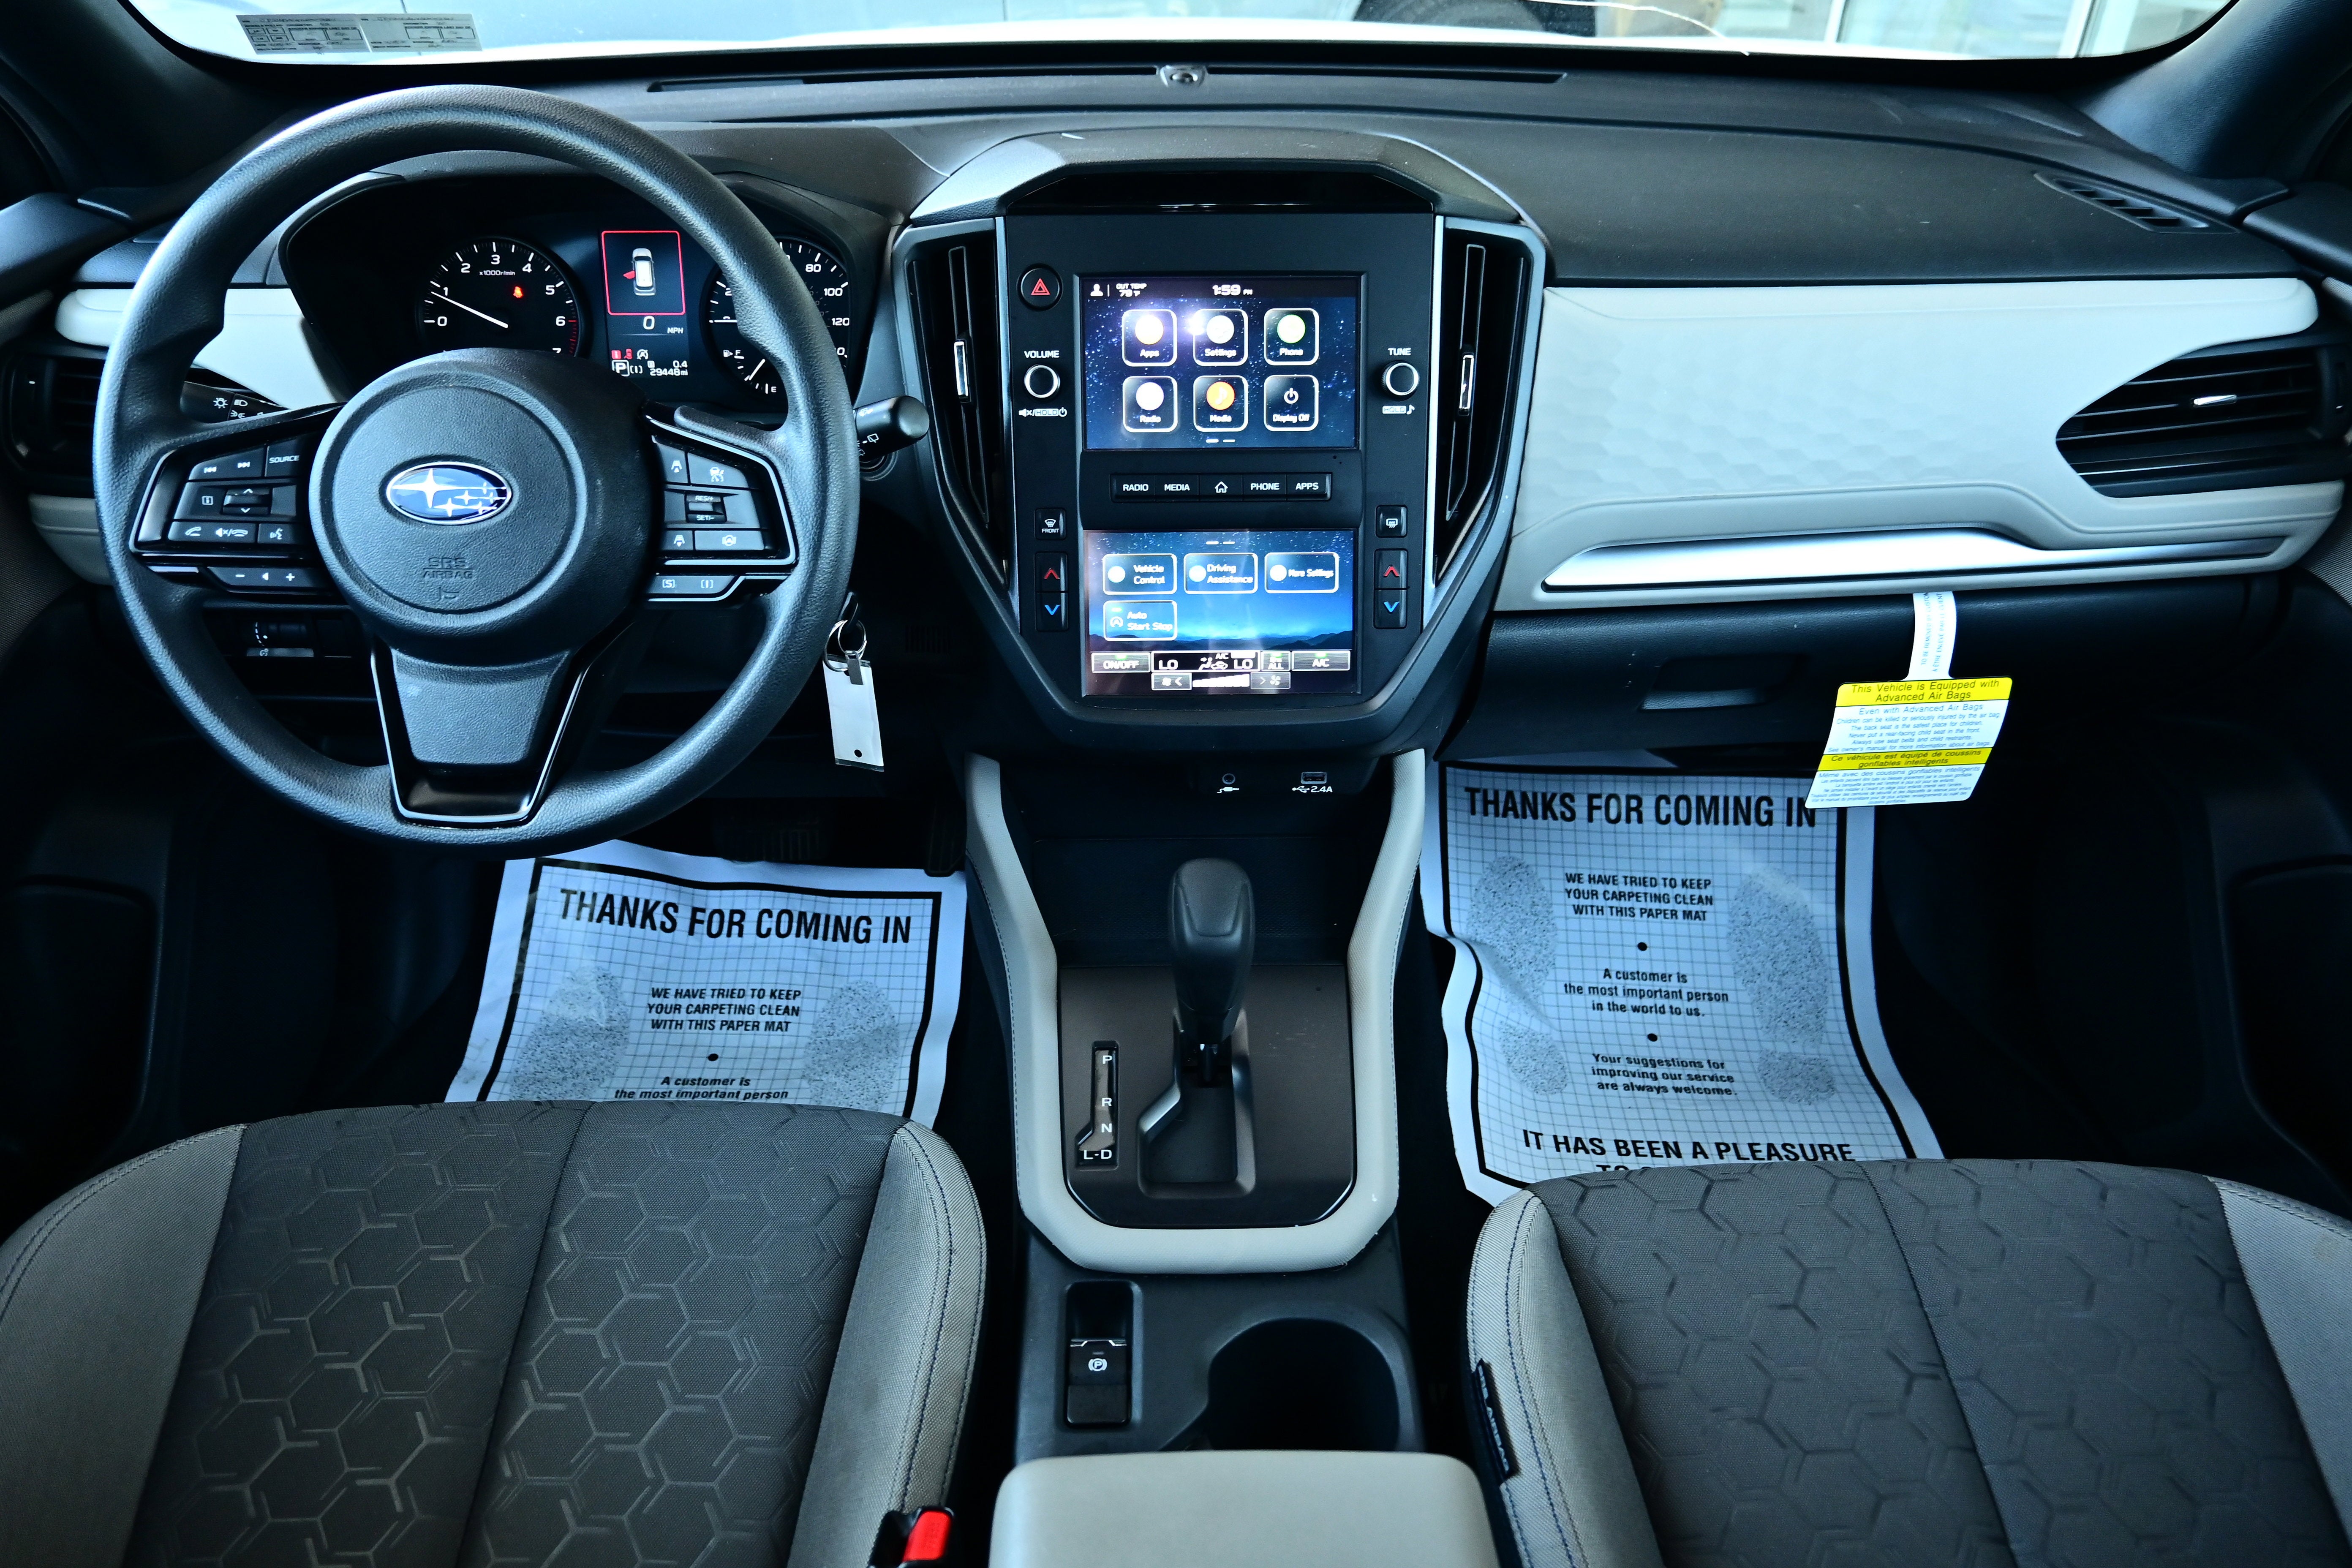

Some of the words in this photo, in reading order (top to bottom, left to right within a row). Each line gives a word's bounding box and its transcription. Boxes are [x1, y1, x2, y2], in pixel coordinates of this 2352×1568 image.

[491, 254, 500, 264] 3
[461, 263, 470, 273] 2
[523, 263, 532, 273] 4
[806, 264, 821, 272] 80
[443, 287, 448, 296] 1
[546, 285, 555, 295] 5
[824, 288, 843, 296] 100
[1212, 284, 1241, 296] 1:59
[437, 316, 447, 326] 0
[556, 316, 565, 326] 6
[643, 316, 655, 329] 0
[832, 318, 850, 326] 120
[1024, 350, 1060, 358] VOLUME
[1140, 349, 1160, 358] Apps
[1205, 348, 1236, 358] Settings
[1279, 348, 1304, 356] Phone
[1388, 348, 1411, 356] TUNE
[615, 363, 626, 373] P
[1140, 415, 1161, 423] Radio
[1210, 414, 1232, 422] Media
[1273, 414, 1297, 423] Display
[1298, 414, 1310, 422] Off
[269, 455, 299, 463] SOURCE
[1164, 483, 1190, 491] MEDIA
[428, 557, 465, 568] SRS
[1133, 565, 1164, 573] Vehicle
[1207, 564, 1236, 574] Driving
[1288, 569, 1305, 577] More
[1307, 569, 1334, 579] Settings
[423, 571, 473, 579] AIRBAG
[1133, 576, 1165, 584] Control
[1207, 575, 1253, 583] Assistance
[1127, 612, 1147, 620] Auto
[1127, 623, 1150, 631] Start
[1152, 623, 1173, 632] Stop
[1103, 660, 1139, 669] ON/OFF
[1159, 660, 1179, 670] LO
[1233, 659, 1253, 669] LO
[1312, 659, 1330, 667] A/C
[1851, 684, 1872, 693] This
[1877, 683, 1912, 692] Vehicle
[1916, 682, 1925, 690] is
[1930, 680, 1976, 691] Equipped
[1875, 692, 1925, 702] Advanced
[1928, 692, 1943, 700] Air
[1946, 691, 1971, 701] Bags
[1963, 703, 1983, 711] Bags
[1901, 751, 1928, 759] équipé
[1859, 760, 1901, 769] gonflables
[1465, 787, 1576, 822] THANKS
[1587, 793, 1644, 824] FOR
[1655, 794, 1774, 826] COMING
[1786, 797, 1816, 828] IN
[1565, 873, 1584, 884] WE
[1588, 874, 1618, 885] HAVE
[1622, 875, 1658, 887] TRIED
[1662, 877, 1677, 888] TO
[1681, 878, 1711, 890] KEEP
[1565, 888, 1599, 900] YOUR
[1603, 890, 1670, 904] CARPETING
[1674, 893, 1713, 905] CLEAN
[560, 888, 678, 933] THANKS
[688, 906, 746, 939] FOR
[756, 908, 872, 944] COMING
[882, 916, 911, 943] IN
[1573, 904, 1604, 915] WITH
[1608, 906, 1636, 918] THIS
[1640, 908, 1678, 920] PAPER
[1682, 910, 1707, 921] MAT
[1603, 968, 1612, 979] A
[1615, 970, 1673, 982] customer
[1677, 972, 1688, 983] is
[651, 988, 671, 999] WE
[674, 988, 707, 999] HAVE
[710, 988, 746, 999] TRIED
[750, 988, 765, 999] TO
[769, 989, 801, 1000] KEEP
[1564, 983, 1583, 994] the
[1588, 985, 1618, 996] most
[1622, 986, 1682, 1000] important
[1687, 991, 1729, 1002] person
[647, 1003, 682, 1014] YOUR
[686, 1004, 755, 1015] CARPETING
[760, 1004, 800, 1017] CLEAN
[1592, 1000, 1603, 1011] in
[1607, 1002, 1627, 1013] the
[1631, 1004, 1666, 1015] world
[1669, 1005, 1682, 1015] to
[1686, 1007, 1705, 1017] us.
[651, 1019, 683, 1030] WITH
[688, 1019, 716, 1031] THIS
[719, 1020, 760, 1032] PAPER
[764, 1021, 791, 1032] MAT
[1102, 1055, 1113, 1064] P
[1592, 1054, 1621, 1064] Your
[1625, 1057, 1704, 1068] suggestions
[1707, 1059, 1724, 1070] for
[1592, 1066, 1658, 1081] improving
[1662, 1072, 1682, 1080] our
[1687, 1073, 1734, 1083] service
[661, 1076, 670, 1086] A
[674, 1077, 735, 1086] customer
[739, 1077, 751, 1086] is
[1597, 1082, 1618, 1090] are
[1622, 1082, 1668, 1094] always
[1672, 1085, 1737, 1096] welcome.
[615, 1089, 635, 1099] the
[639, 1090, 673, 1099] most
[676, 1089, 741, 1100] important
[743, 1090, 789, 1101] person
[1102, 1097, 1112, 1107] R
[1101, 1123, 1112, 1133] N
[1523, 1129, 1543, 1150] IT
[1553, 1135, 1606, 1156] HAS
[1614, 1139, 1682, 1159] BEEN
[1692, 1141, 1709, 1160] A
[1715, 1142, 1856, 1162] PLEASURE
